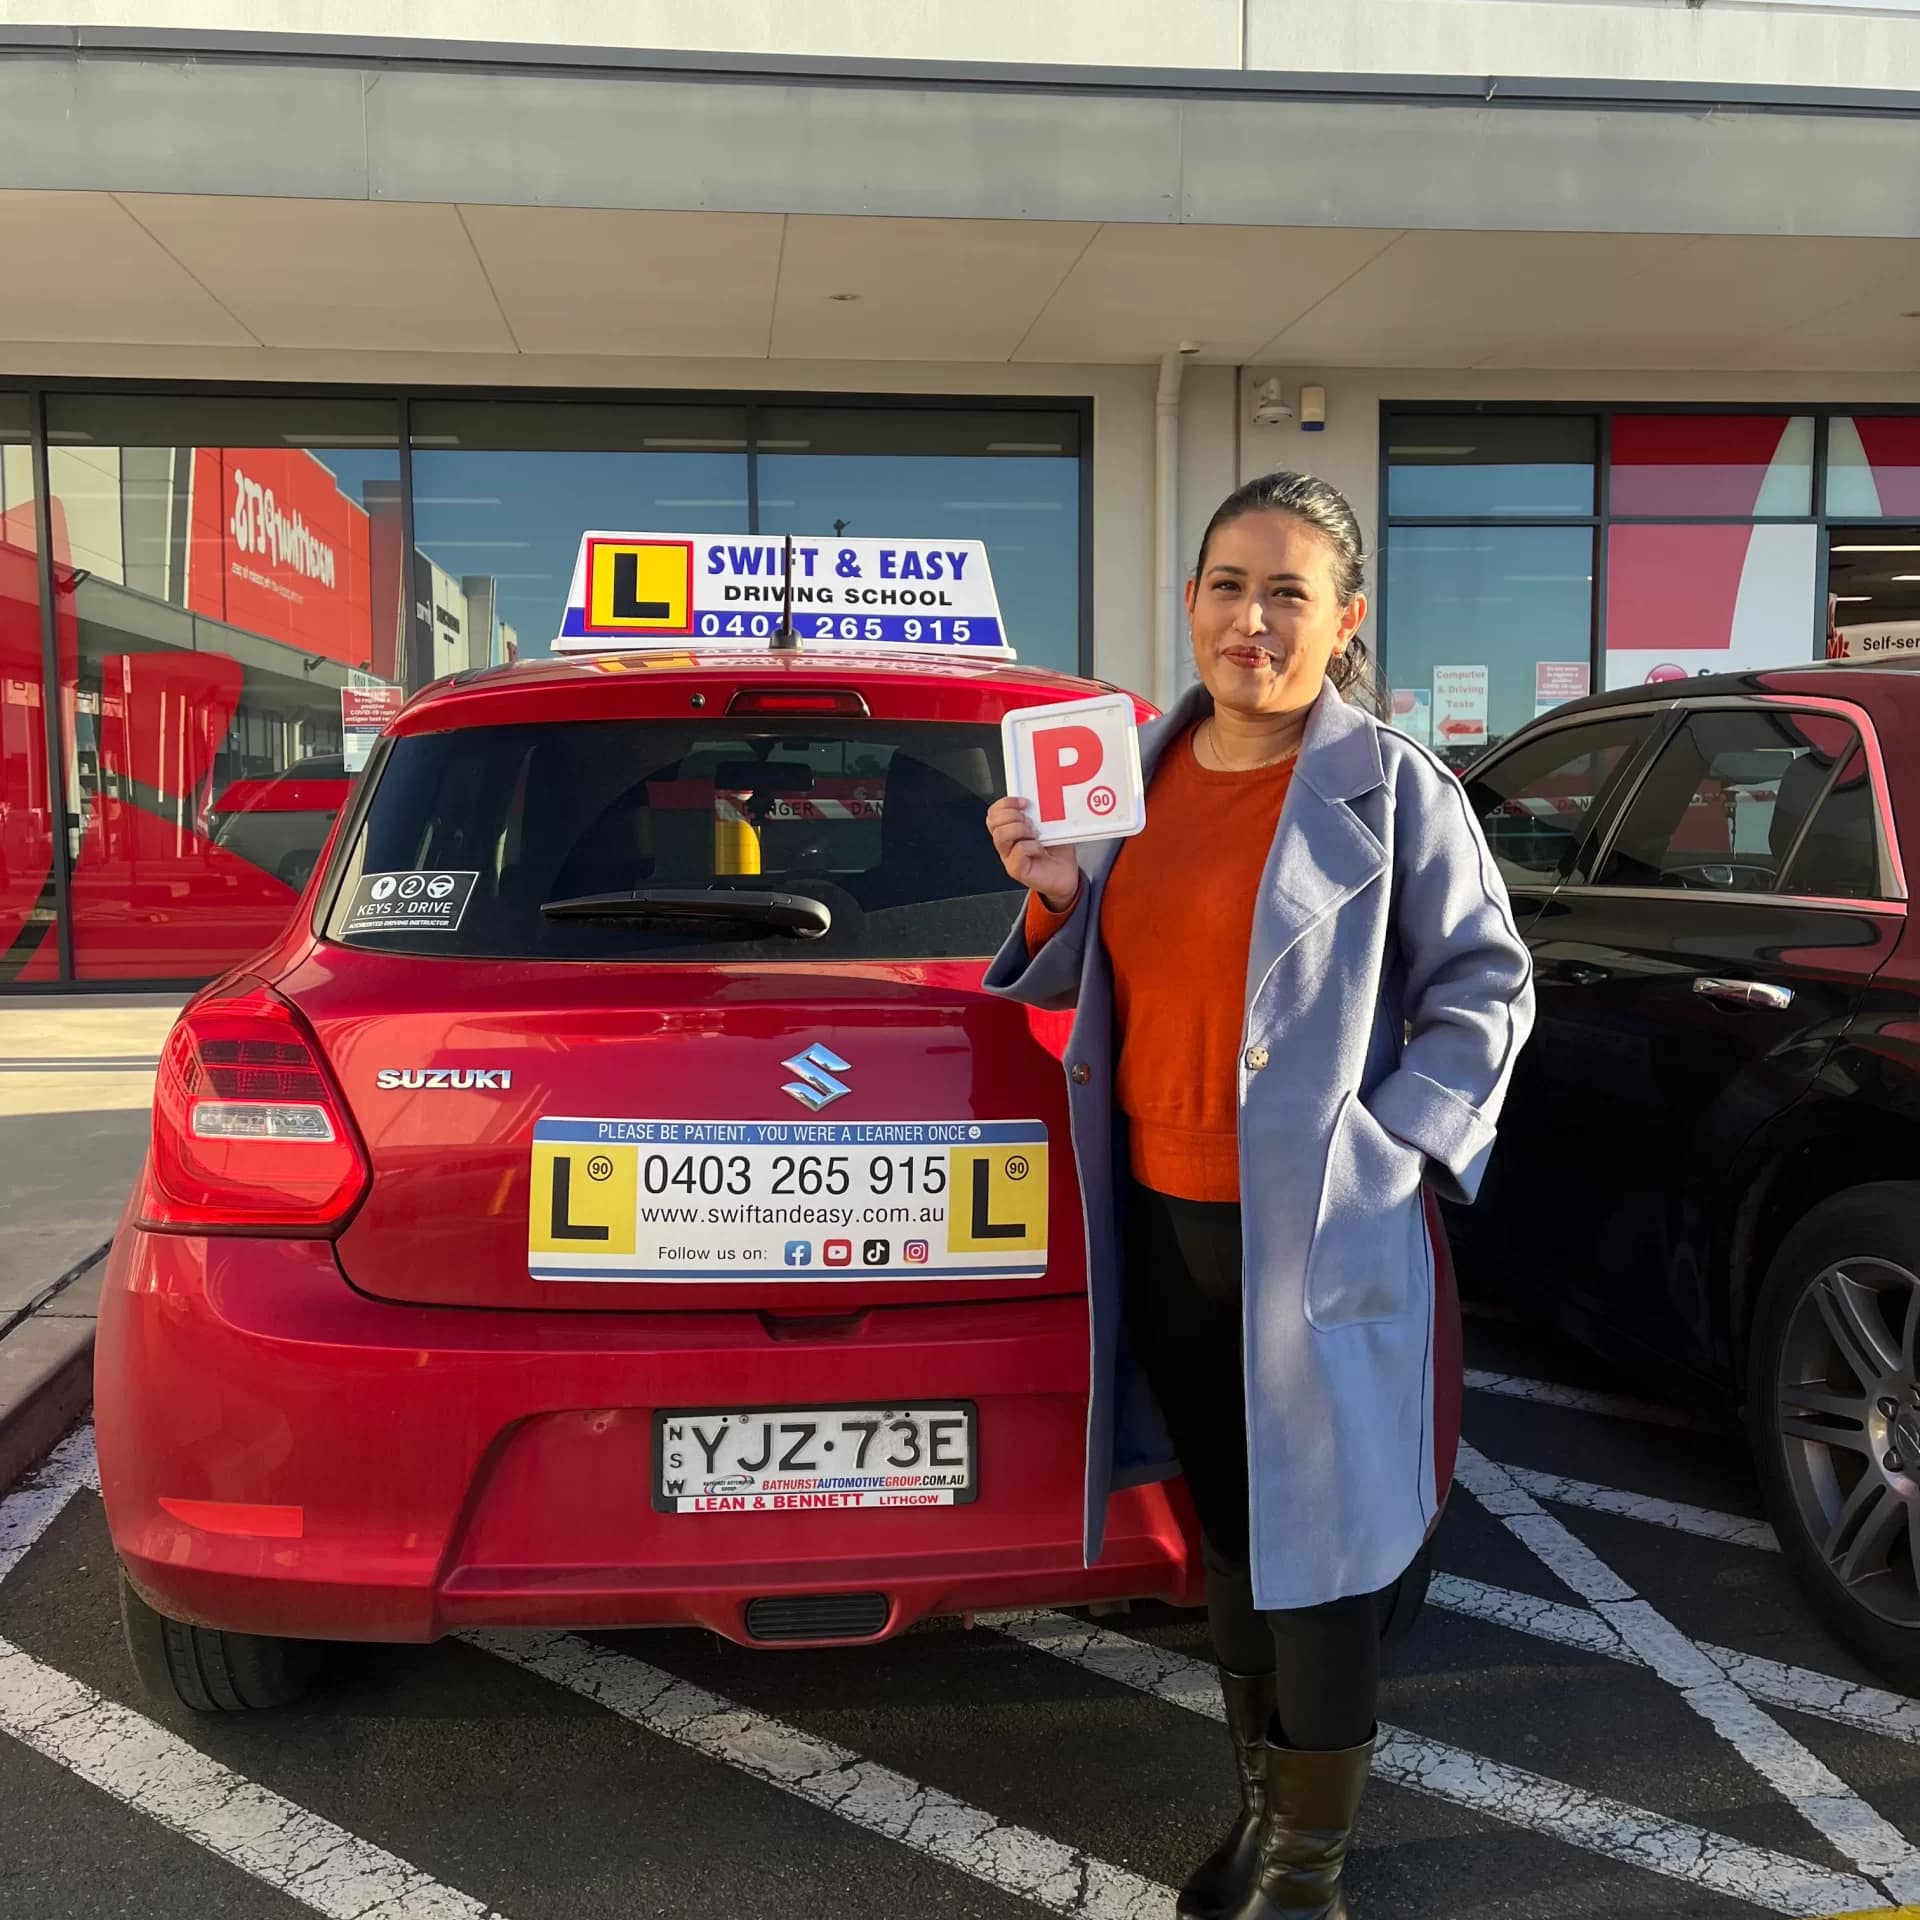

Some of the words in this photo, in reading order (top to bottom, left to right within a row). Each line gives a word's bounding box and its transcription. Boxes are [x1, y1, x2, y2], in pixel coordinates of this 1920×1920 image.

[707, 546, 818, 576] SWIFT
[835, 549, 862, 578] &
[880, 550, 968, 580] EASY
[613, 553, 670, 619] L
[725, 585, 833, 603] DRIVING
[844, 588, 952, 606] SCHOOL
[701, 614, 786, 637] 040
[816, 617, 882, 640] 265
[904, 619, 970, 641] 915
[1032, 725, 1104, 823] P
[1093, 794, 1110, 807] 90
[404, 880, 418, 894] 2
[357, 902, 393, 916] KEYS
[395, 902, 405, 914] 2
[407, 902, 454, 914] DRIVE
[376, 1069, 512, 1089] SUZUKI
[599, 1123, 654, 1140] PLEASE
[660, 1125, 676, 1140] BE
[685, 1125, 750, 1142] PATIENT,
[757, 1126, 788, 1141] YOU
[793, 1126, 835, 1141] WERE
[841, 1126, 851, 1141] A
[857, 1126, 923, 1141] LEARNER
[928, 1126, 966, 1140] ONCE
[592, 1162, 609, 1175] 90
[644, 1154, 751, 1195] 0403
[771, 1155, 850, 1195] 265
[869, 1155, 946, 1195] 915
[1009, 1162, 1025, 1174] 90
[551, 1156, 609, 1240] L
[972, 1159, 1026, 1239] L
[641, 1204, 944, 1227] www.swiftandeasy.com.au
[658, 1246, 710, 1260] Follow
[717, 1249, 736, 1260] us
[742, 1249, 768, 1260] on:
[762, 1474, 964, 1490] BATHURSTAUTOMOTIVEGROUP.COM.AU
[695, 1496, 745, 1511] LEAN
[753, 1495, 766, 1509] &
[773, 1493, 864, 1509] BENNETT
[880, 1495, 939, 1505] LITHGOW
